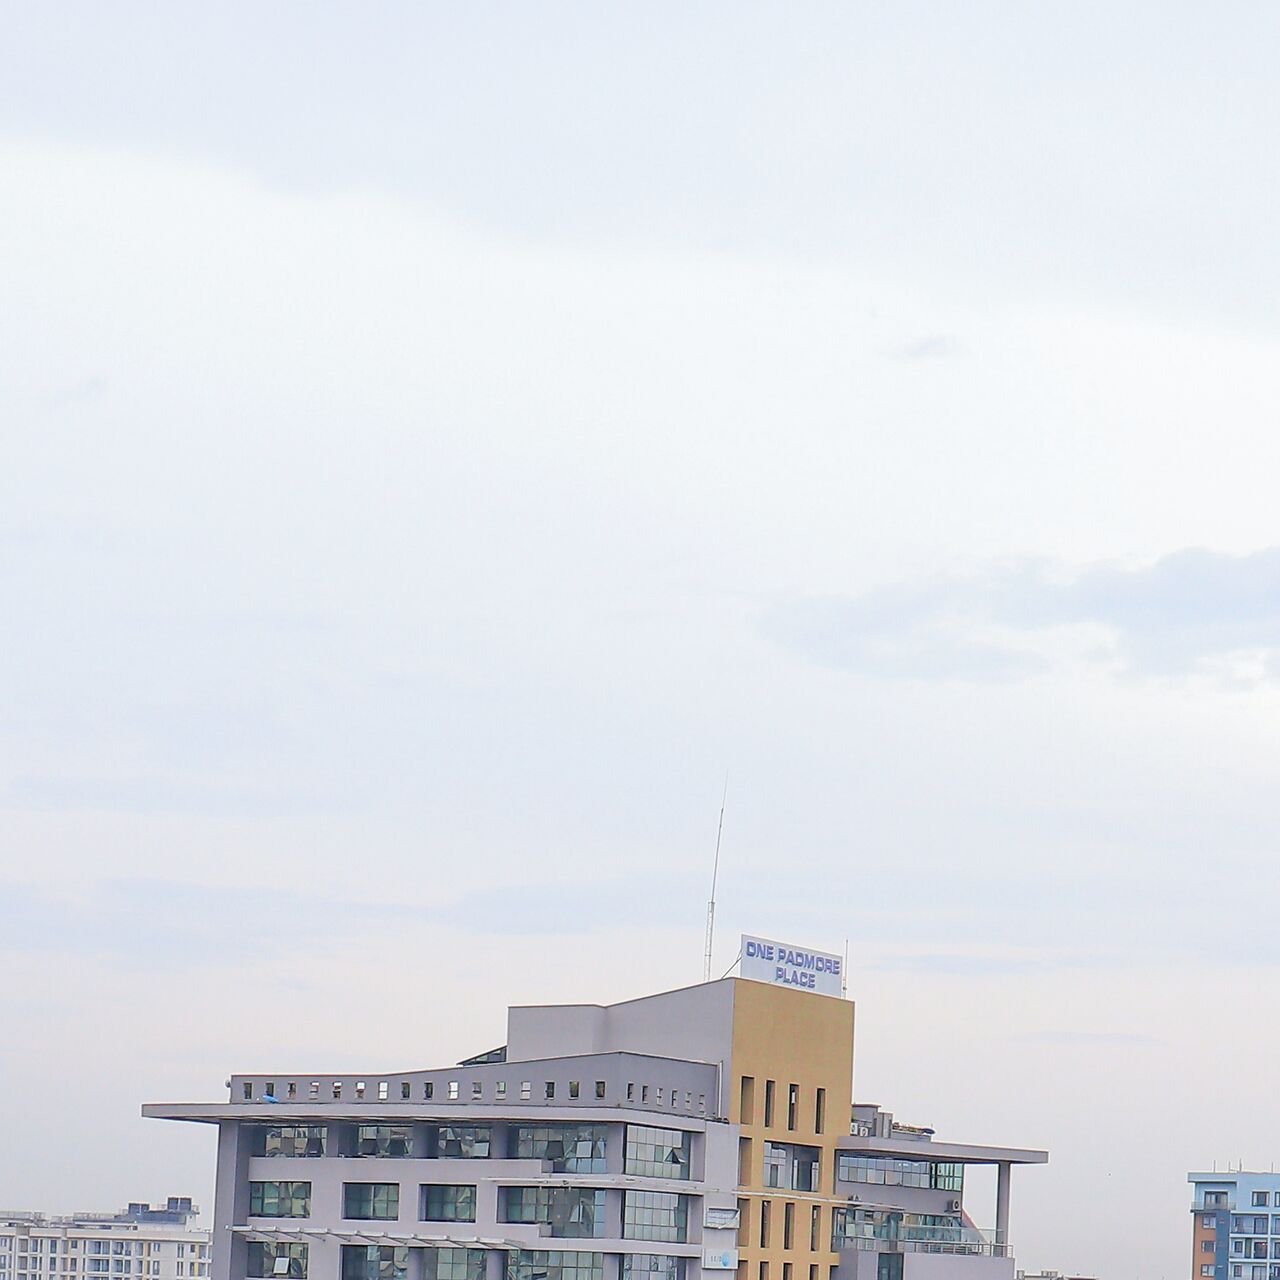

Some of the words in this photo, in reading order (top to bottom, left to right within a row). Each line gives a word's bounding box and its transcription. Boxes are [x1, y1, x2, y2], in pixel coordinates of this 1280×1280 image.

[746, 941, 774, 960] ONE
[777, 948, 840, 974] PADMORE
[775, 966, 815, 988] PLACE
